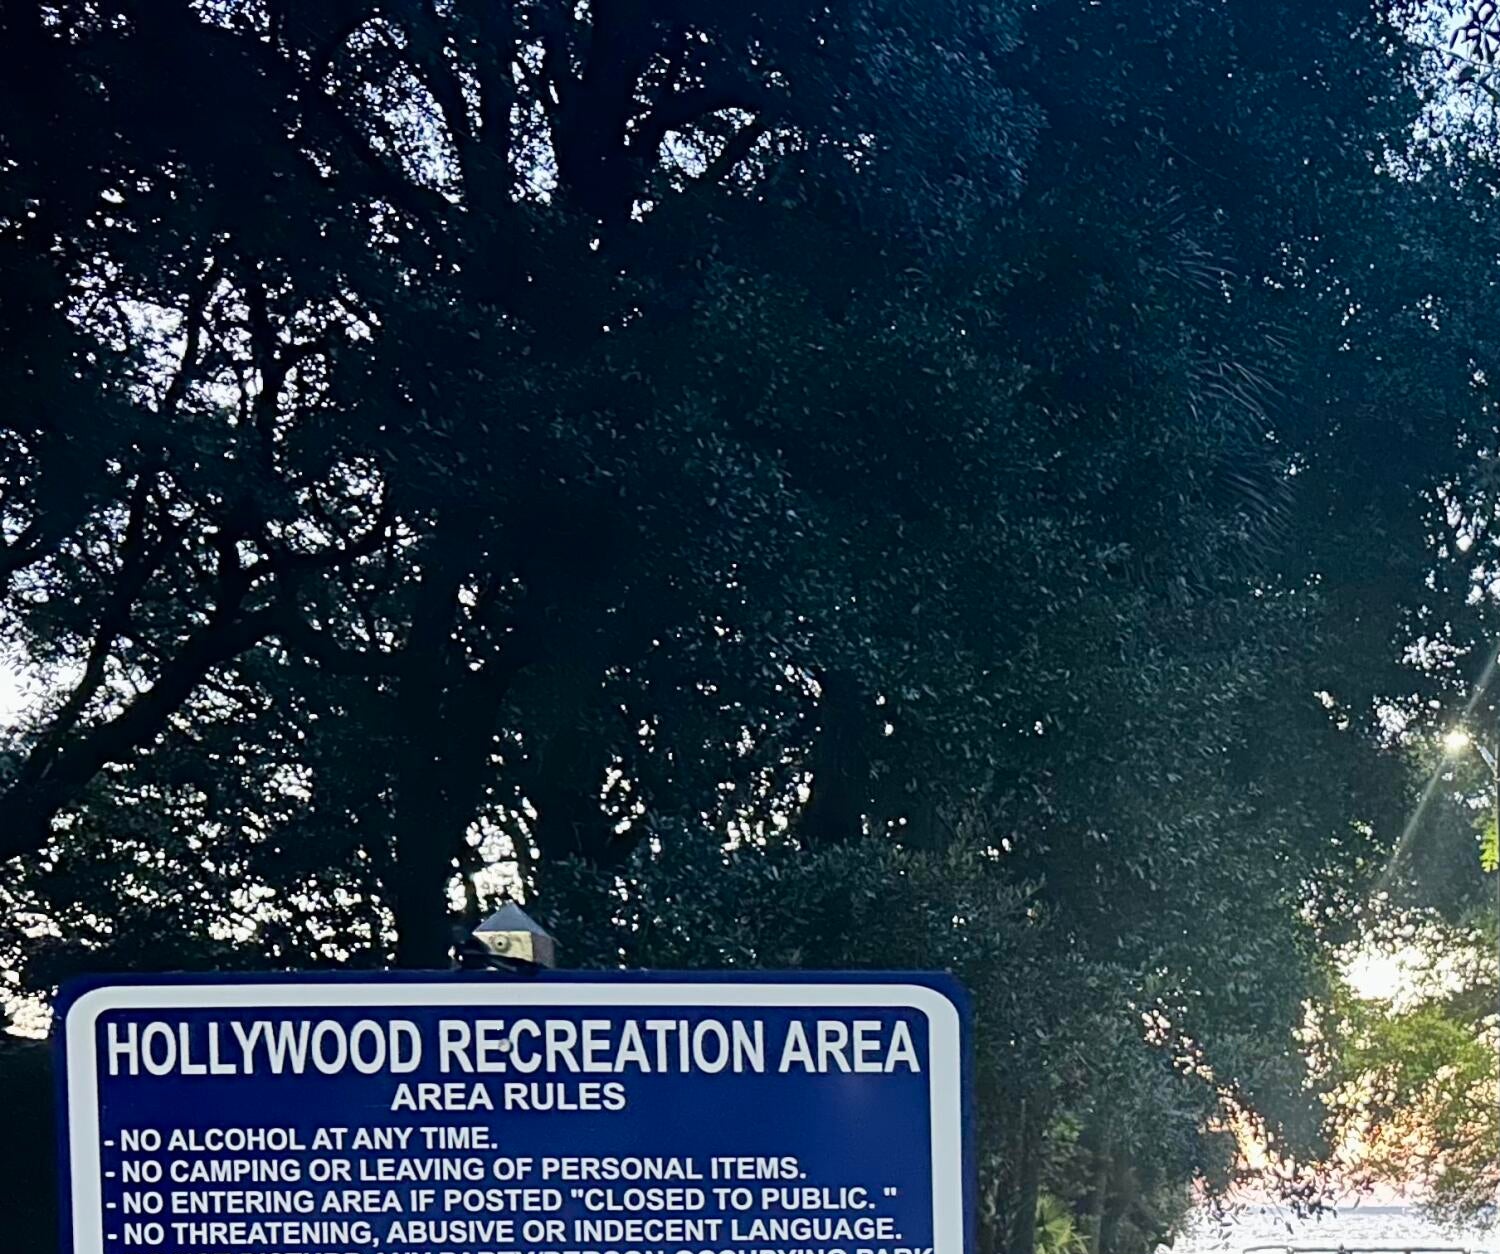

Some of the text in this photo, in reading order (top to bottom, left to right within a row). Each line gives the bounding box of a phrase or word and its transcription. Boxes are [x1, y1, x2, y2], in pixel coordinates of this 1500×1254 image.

[108, 1019, 920, 1075] HOLLYWOOD RECREATION AREA
[391, 1083, 625, 1110] AREA RULES
[121, 1129, 161, 1151] NO
[168, 1128, 306, 1151] ALCOHOL
[312, 1128, 348, 1150] AT
[352, 1127, 413, 1149] ANY
[420, 1127, 497, 1149] TIME.
[122, 1160, 162, 1182] NO
[171, 1159, 300, 1182] CAMPING
[309, 1159, 351, 1181] OR
[360, 1158, 484, 1181] LEAVING
[494, 1158, 532, 1180] OF
[543, 1158, 703, 1179] PERSONAL
[712, 1157, 806, 1179] ITEMS.
[123, 1192, 163, 1213] NO
[171, 1190, 314, 1213] ENTERING
[321, 1190, 402, 1212] AREA
[411, 1190, 435, 1211] IF
[445, 1189, 562, 1211] POSTED
[571, 1189, 704, 1210] "CLOSED
[713, 1188, 752, 1210] TO
[125, 1223, 164, 1244] NO
[171, 1221, 378, 1247] THREATENING,
[387, 1221, 514, 1243] ABUSIVE
[523, 1220, 566, 1242] OR
[575, 1219, 722, 1242] INDECENT
[732, 1218, 901, 1240] LANGUAGE.
